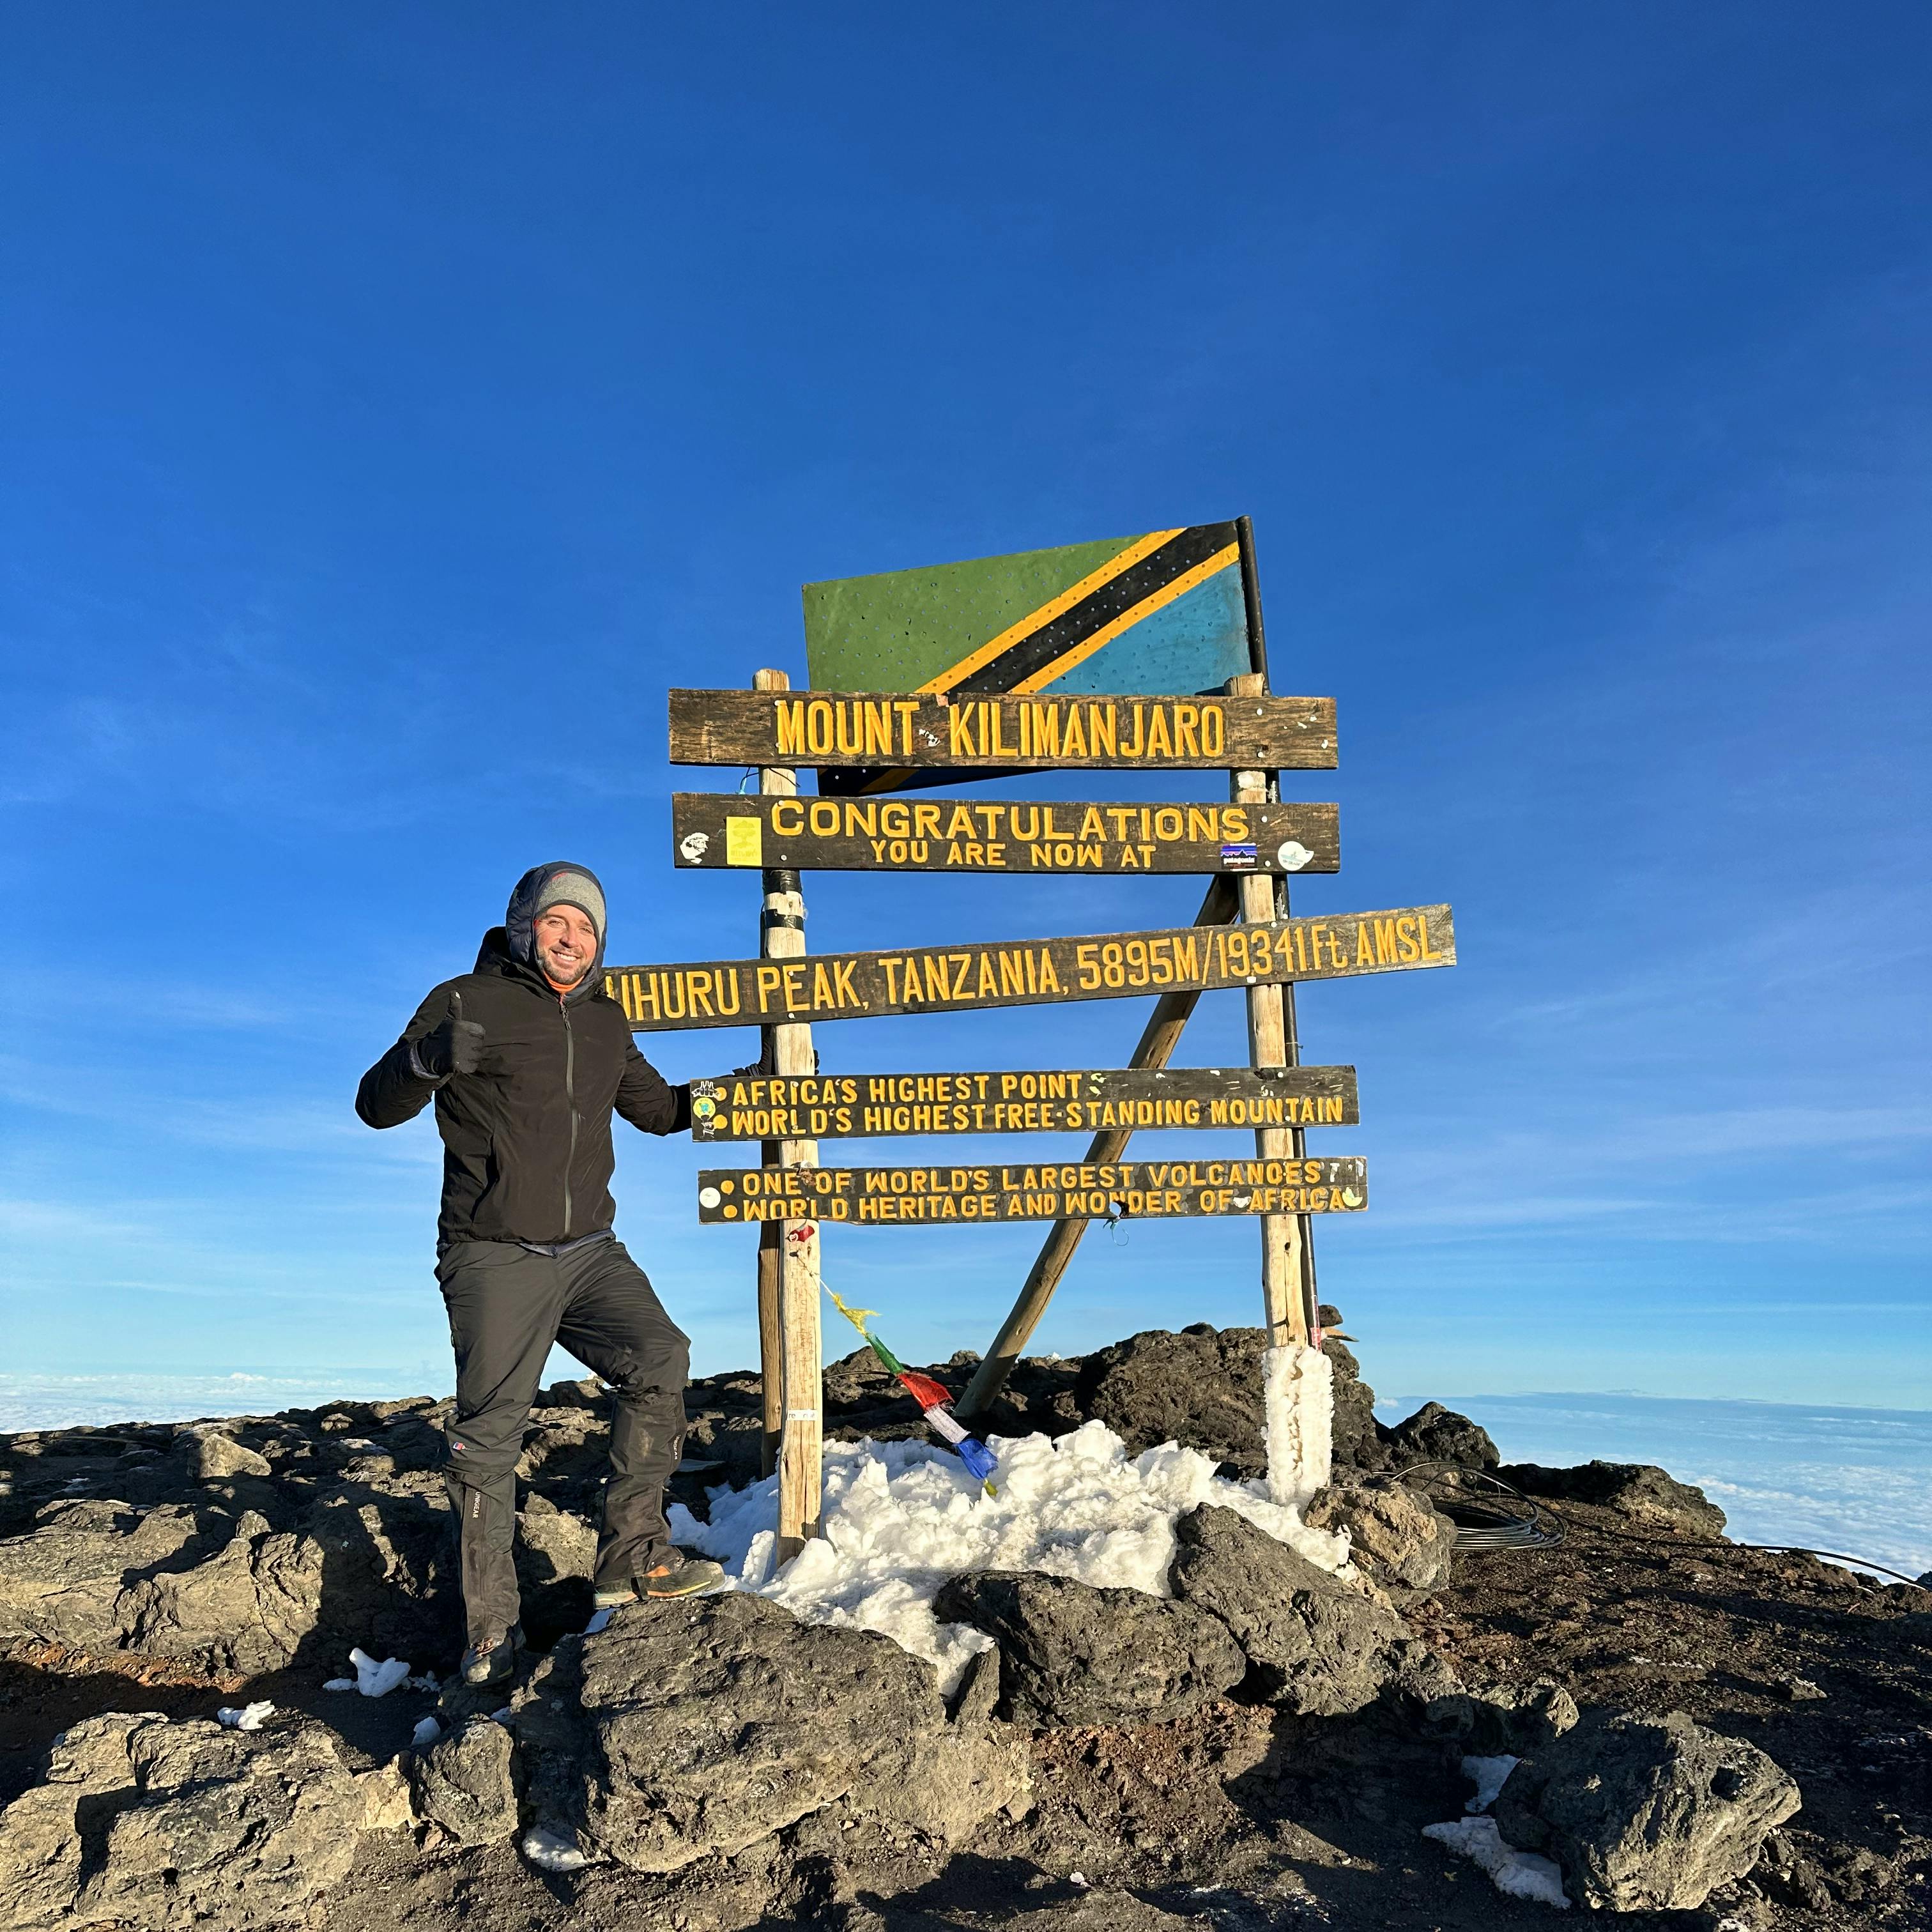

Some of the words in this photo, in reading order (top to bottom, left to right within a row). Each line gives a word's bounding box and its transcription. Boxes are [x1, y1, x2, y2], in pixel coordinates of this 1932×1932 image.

[775, 700, 920, 756] MOUNT
[949, 702, 1223, 758] KILIMANJARO
[771, 800, 1250, 842] CONGRATULATIONS
[870, 839, 928, 864] YOU
[947, 841, 1006, 866] ARE
[1031, 843, 1103, 868] NOW
[1121, 844, 1156, 868] AT
[756, 960, 870, 1011] PEAK,
[878, 947, 1069, 1004] TANZANIA,
[1356, 915, 1442, 967] AMSL
[869, 1075, 990, 1103] HIGHEST
[1001, 1073, 1082, 1099] POINT
[732, 1107, 852, 1135] WORLD'S
[864, 1103, 985, 1131] HIGHEST
[1210, 1096, 1343, 1125] MOUNTAIN
[742, 1172, 802, 1196] ONE
[814, 1172, 852, 1194] OF
[866, 1170, 990, 1193] WORLD'S
[1002, 1165, 1134, 1191] LARGEST
[1148, 1160, 1321, 1188] VOLCANOES
[743, 1198, 848, 1221] WORLD
[859, 1195, 997, 1220] HERITAGE
[1008, 1193, 1057, 1216] AND
[1200, 1189, 1234, 1213] OF
[1249, 1187, 1346, 1211] AFRICA
[472, 1491, 481, 1519] UNIGEAR
